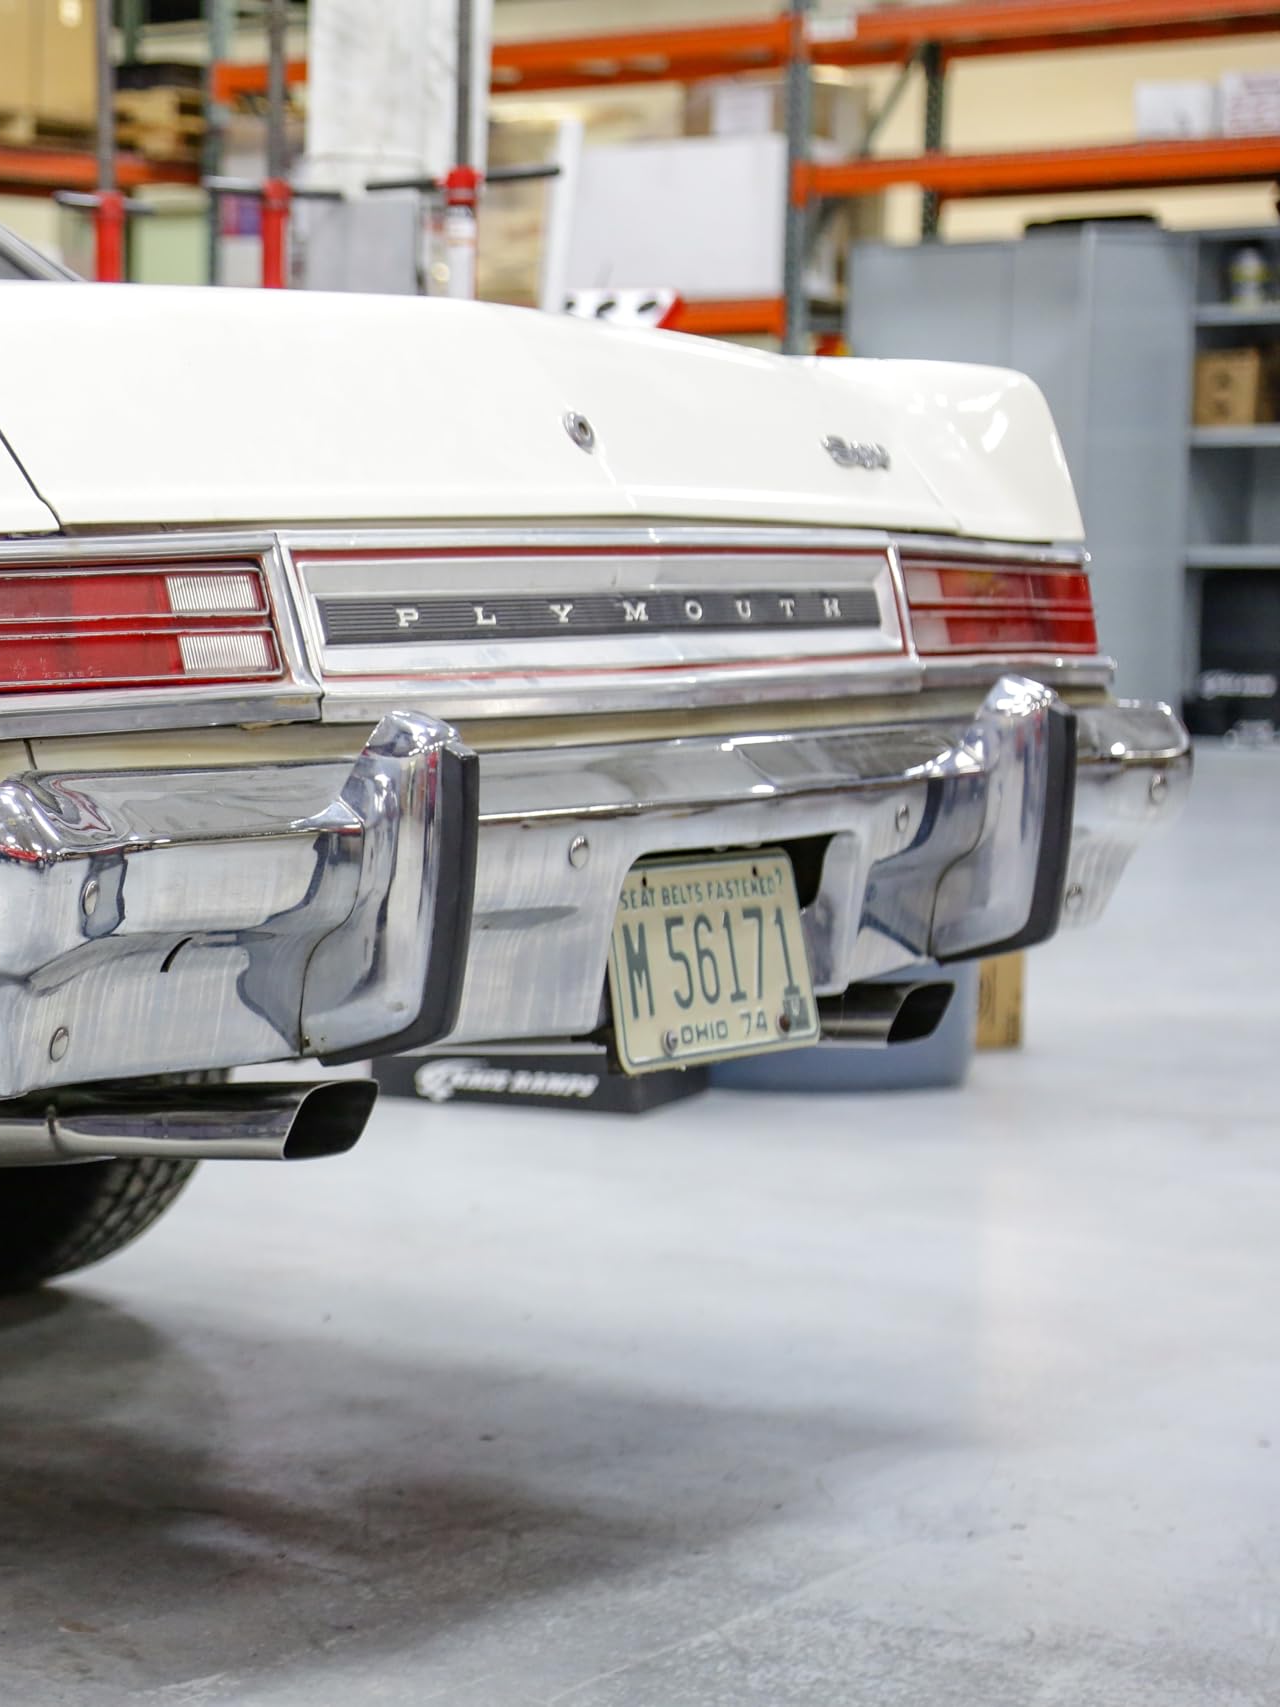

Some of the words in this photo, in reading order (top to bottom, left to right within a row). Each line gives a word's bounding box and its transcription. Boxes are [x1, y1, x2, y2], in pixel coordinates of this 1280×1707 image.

[395, 597, 842, 629] PLYMOUTH
[620, 887, 656, 911] SEAT
[661, 881, 703, 906] BELTS
[622, 922, 656, 1020] M
[664, 906, 801, 1010] 56171
[681, 1020, 729, 1044] OHIO
[740, 1011, 768, 1036] 74
